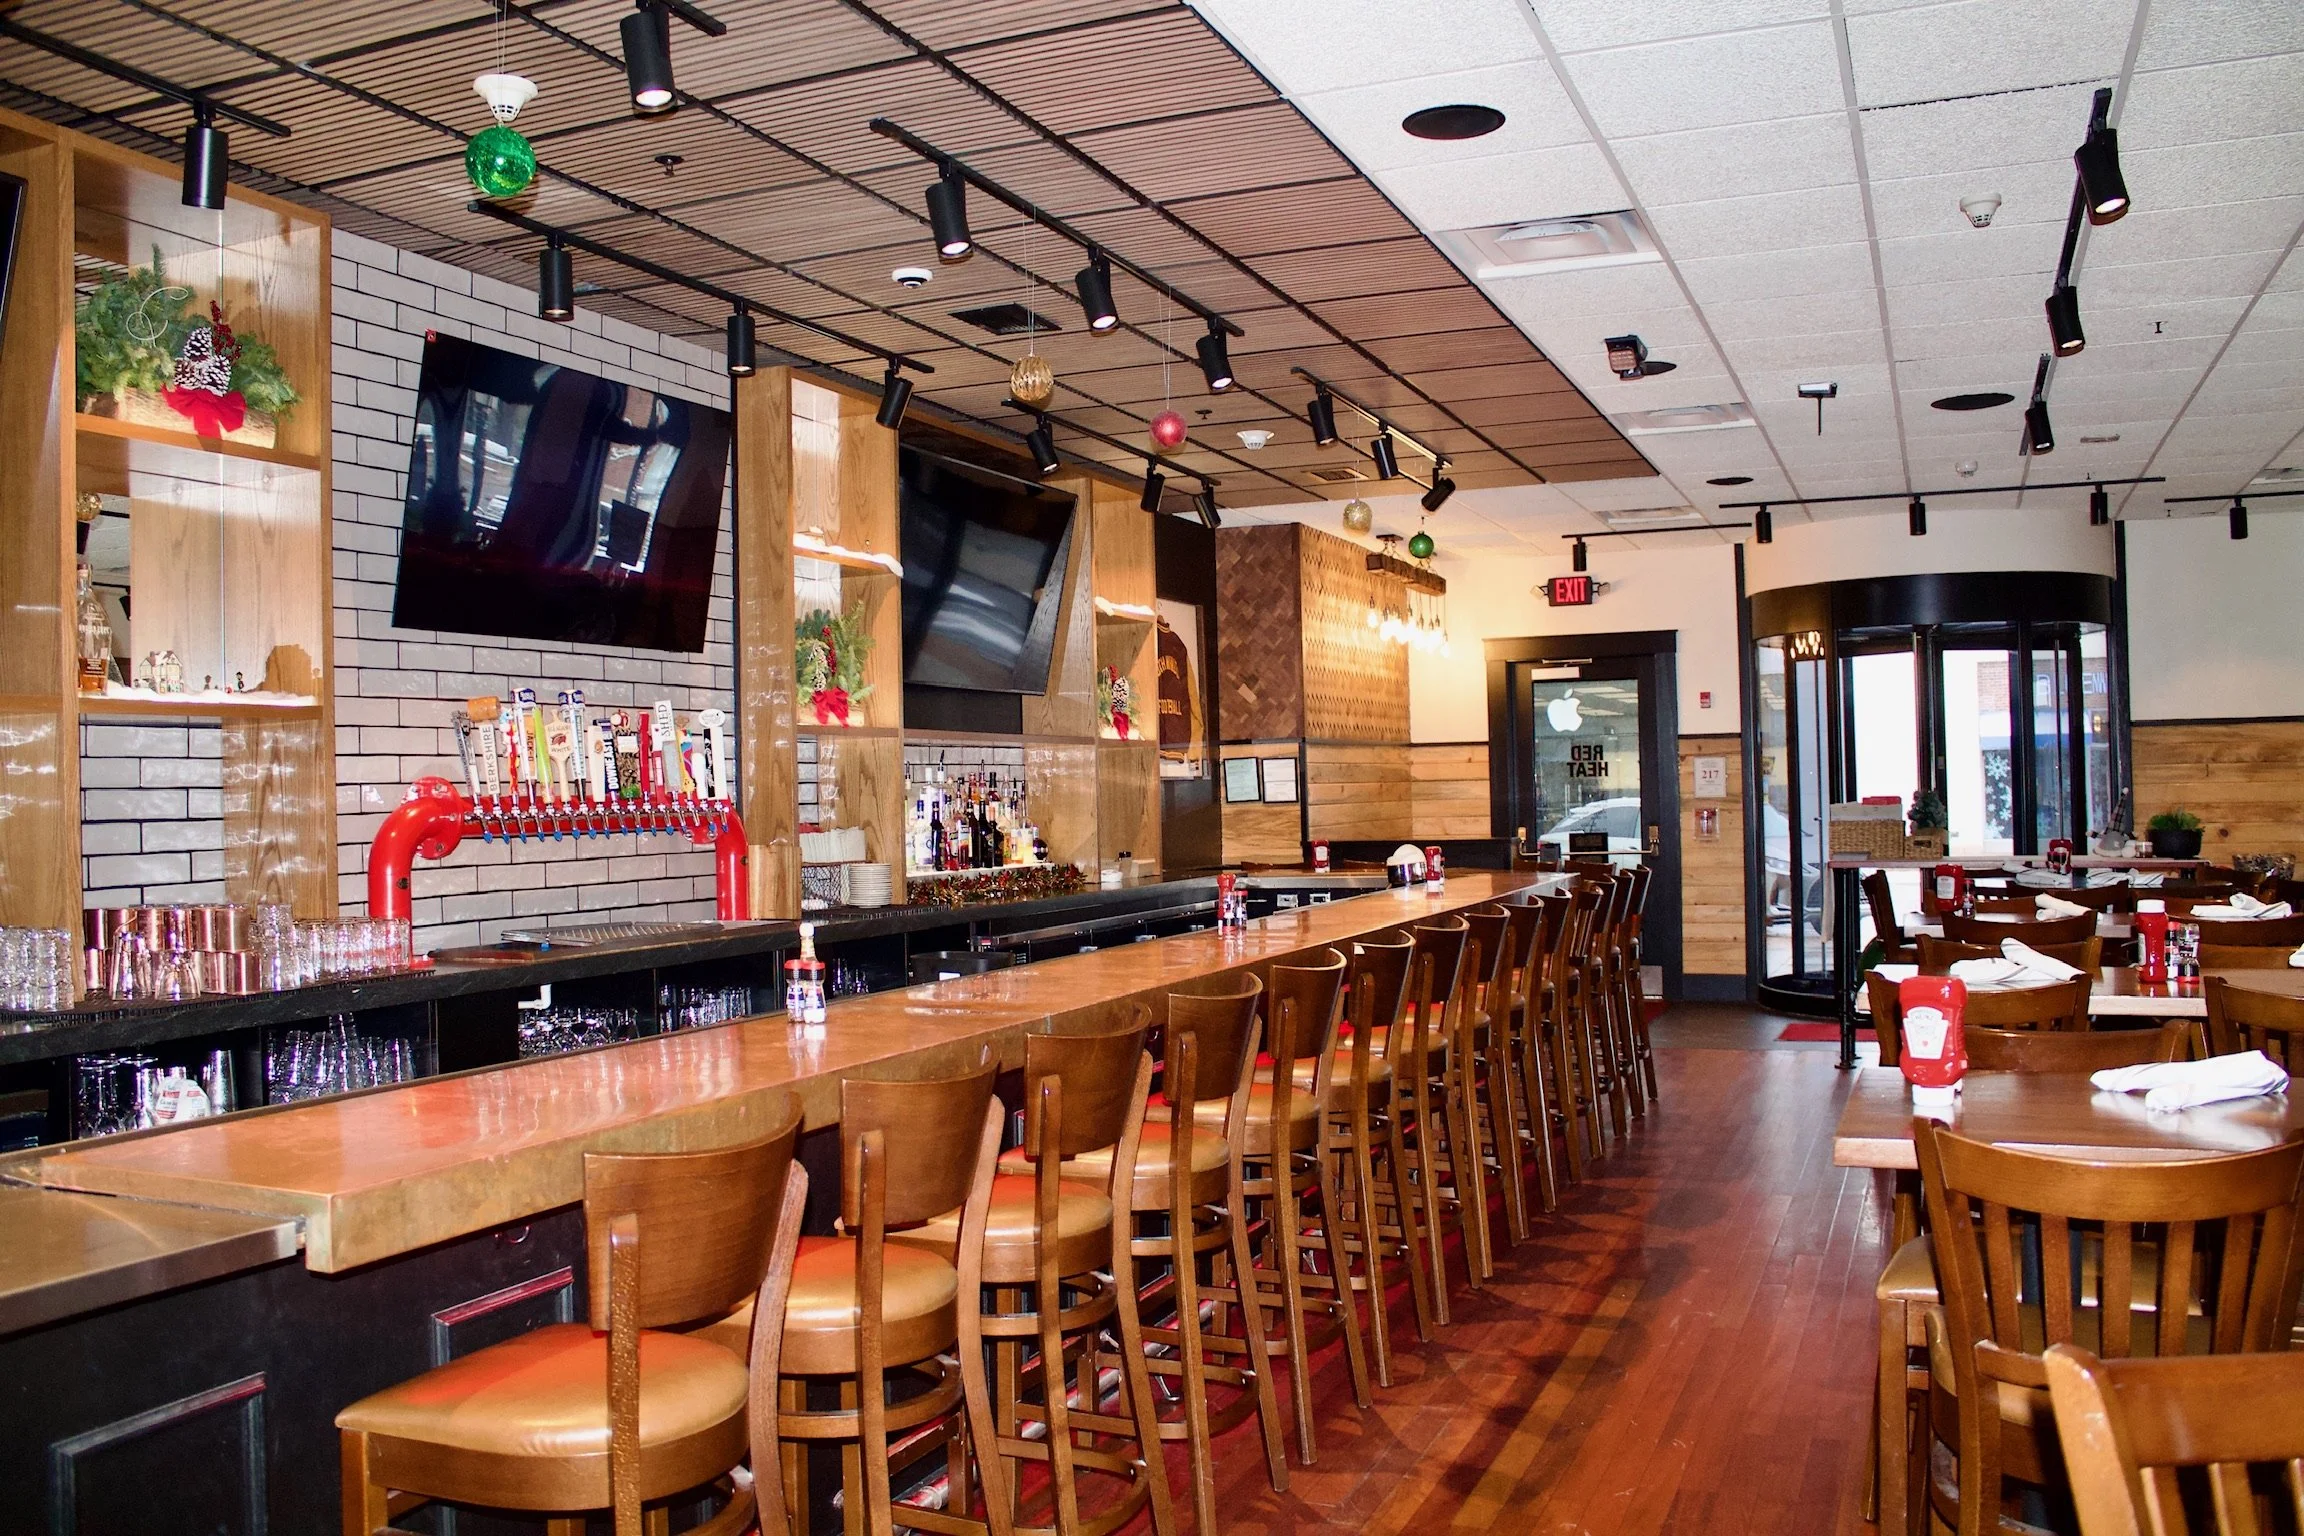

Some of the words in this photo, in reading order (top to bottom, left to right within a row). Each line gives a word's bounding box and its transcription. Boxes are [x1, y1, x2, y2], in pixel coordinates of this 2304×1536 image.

[1555, 577, 1587, 603] EXIT
[482, 726, 498, 792] BERKSHIRE
[603, 738, 619, 790] DOWNEAST
[1701, 770, 1719, 779] 217
